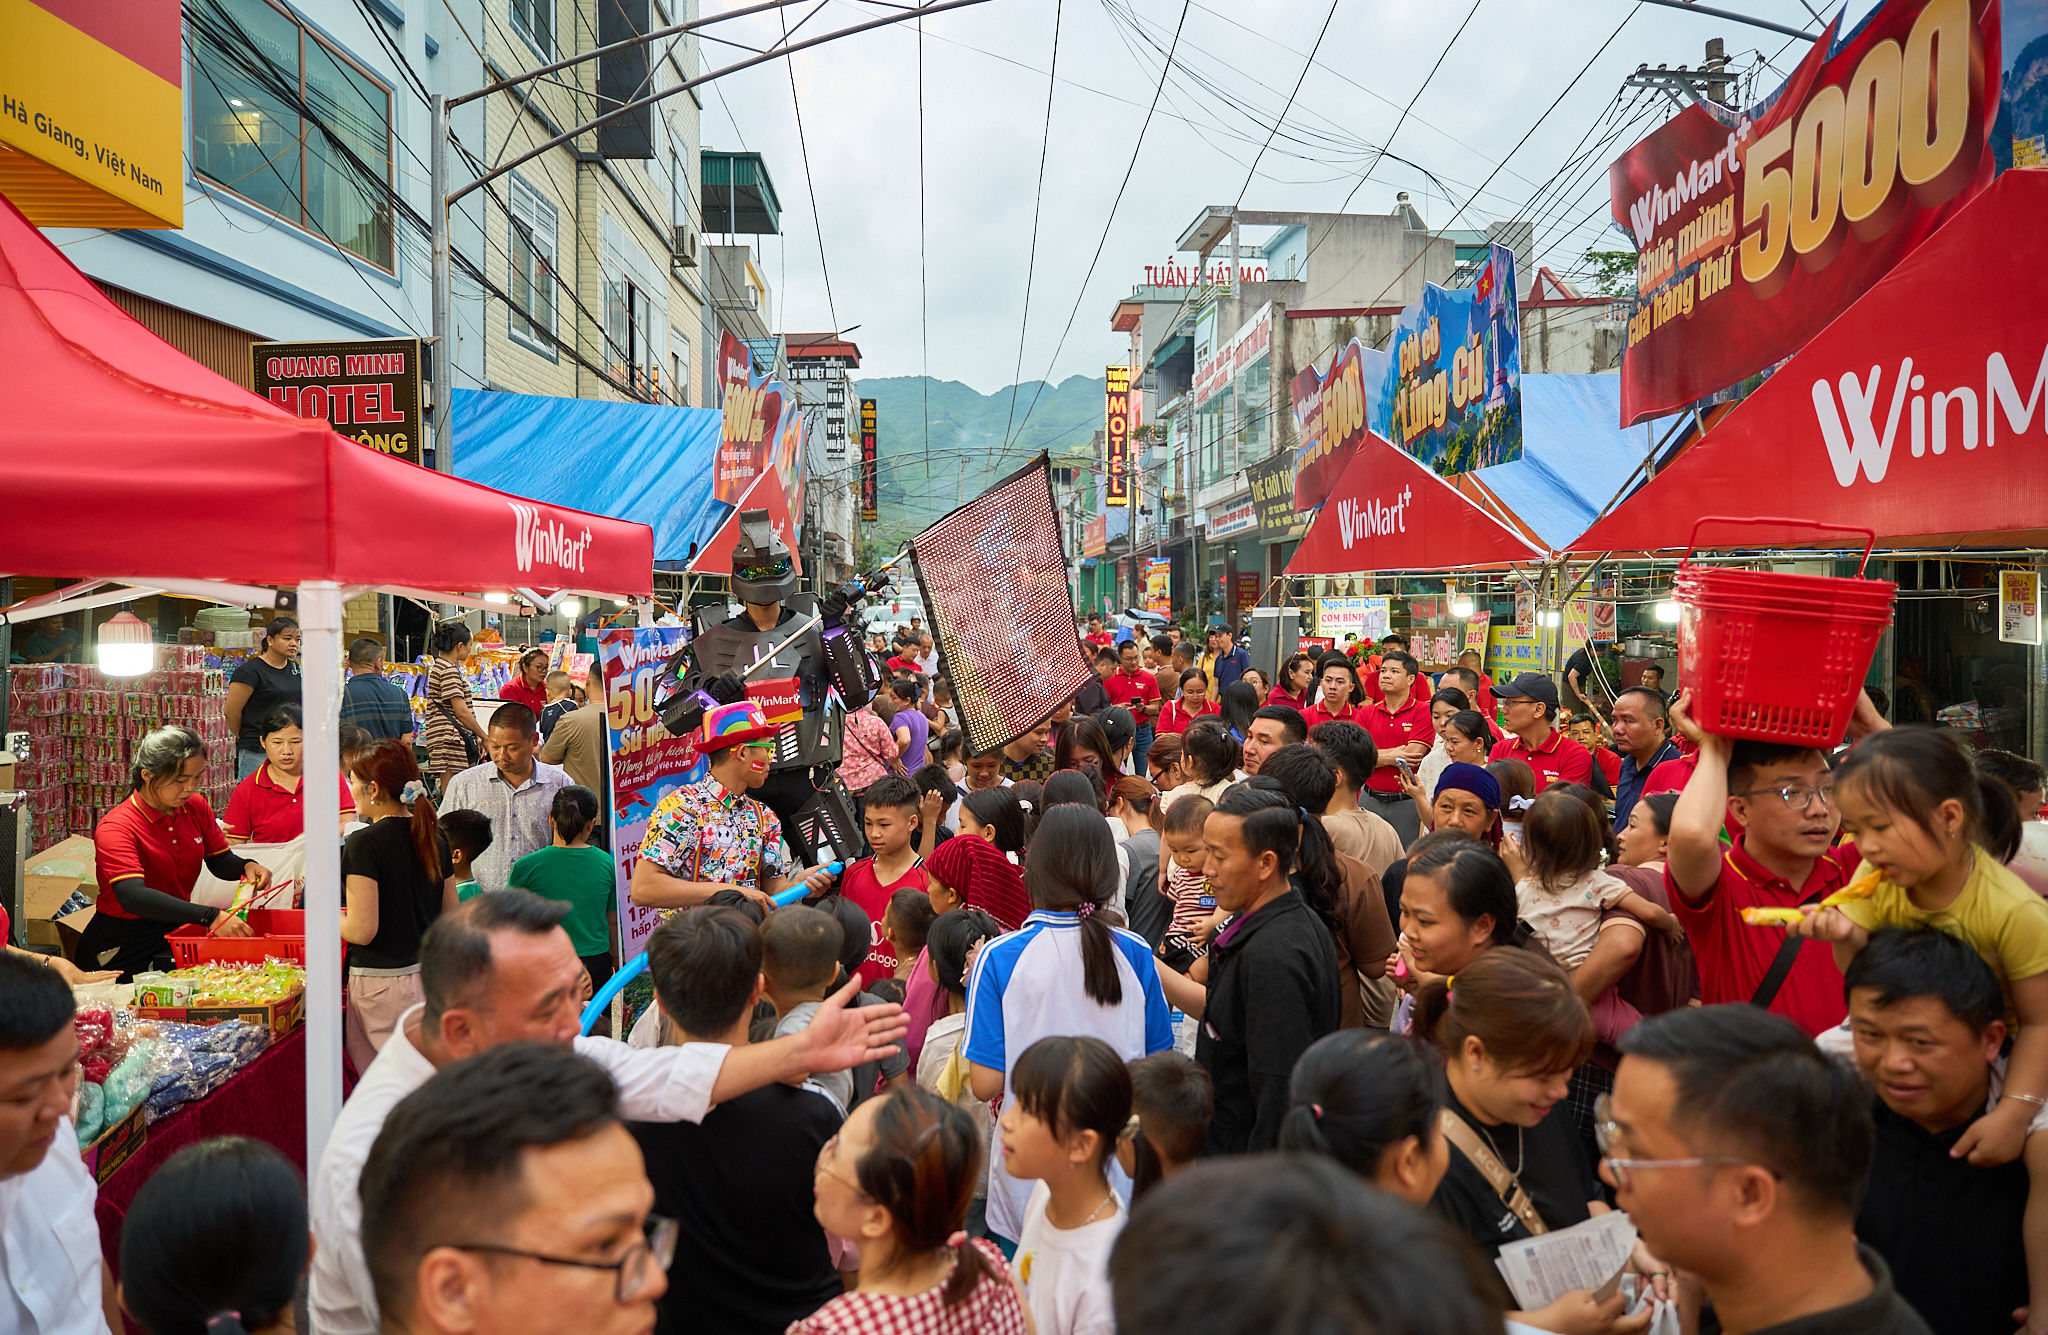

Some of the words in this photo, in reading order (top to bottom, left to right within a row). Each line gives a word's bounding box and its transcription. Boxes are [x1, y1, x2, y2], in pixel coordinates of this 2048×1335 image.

[3, 93, 28, 125] Hà
[34, 112, 90, 161] Giang,
[94, 143, 126, 177] Việt
[130, 163, 163, 196] Nam
[1740, 0, 1971, 283] 5000
[1677, 193, 1735, 261] mừng
[1144, 255, 1188, 288] TUẤN
[1240, 266, 1268, 283] MO
[1627, 296, 1651, 349] cửa
[1652, 272, 1695, 330] hàng
[1697, 244, 1735, 304] thứ
[266, 355, 341, 381] QUANG
[345, 352, 405, 377] MINH
[1400, 369, 1448, 442] Lũng
[1452, 331, 1483, 409] Cú
[268, 382, 405, 425] HOTEL
[722, 382, 757, 442] 5000
[1322, 356, 1364, 456] 5000
[350, 430, 408, 454] ÒNG
[1108, 395, 1128, 495] MOTEL
[1345, 598, 1361, 608] Lan
[676, 759, 692, 768] Nam
[628, 906, 637, 922] 1
[631, 919, 652, 940] hấp
[1473, 1147, 1505, 1185] MCM
